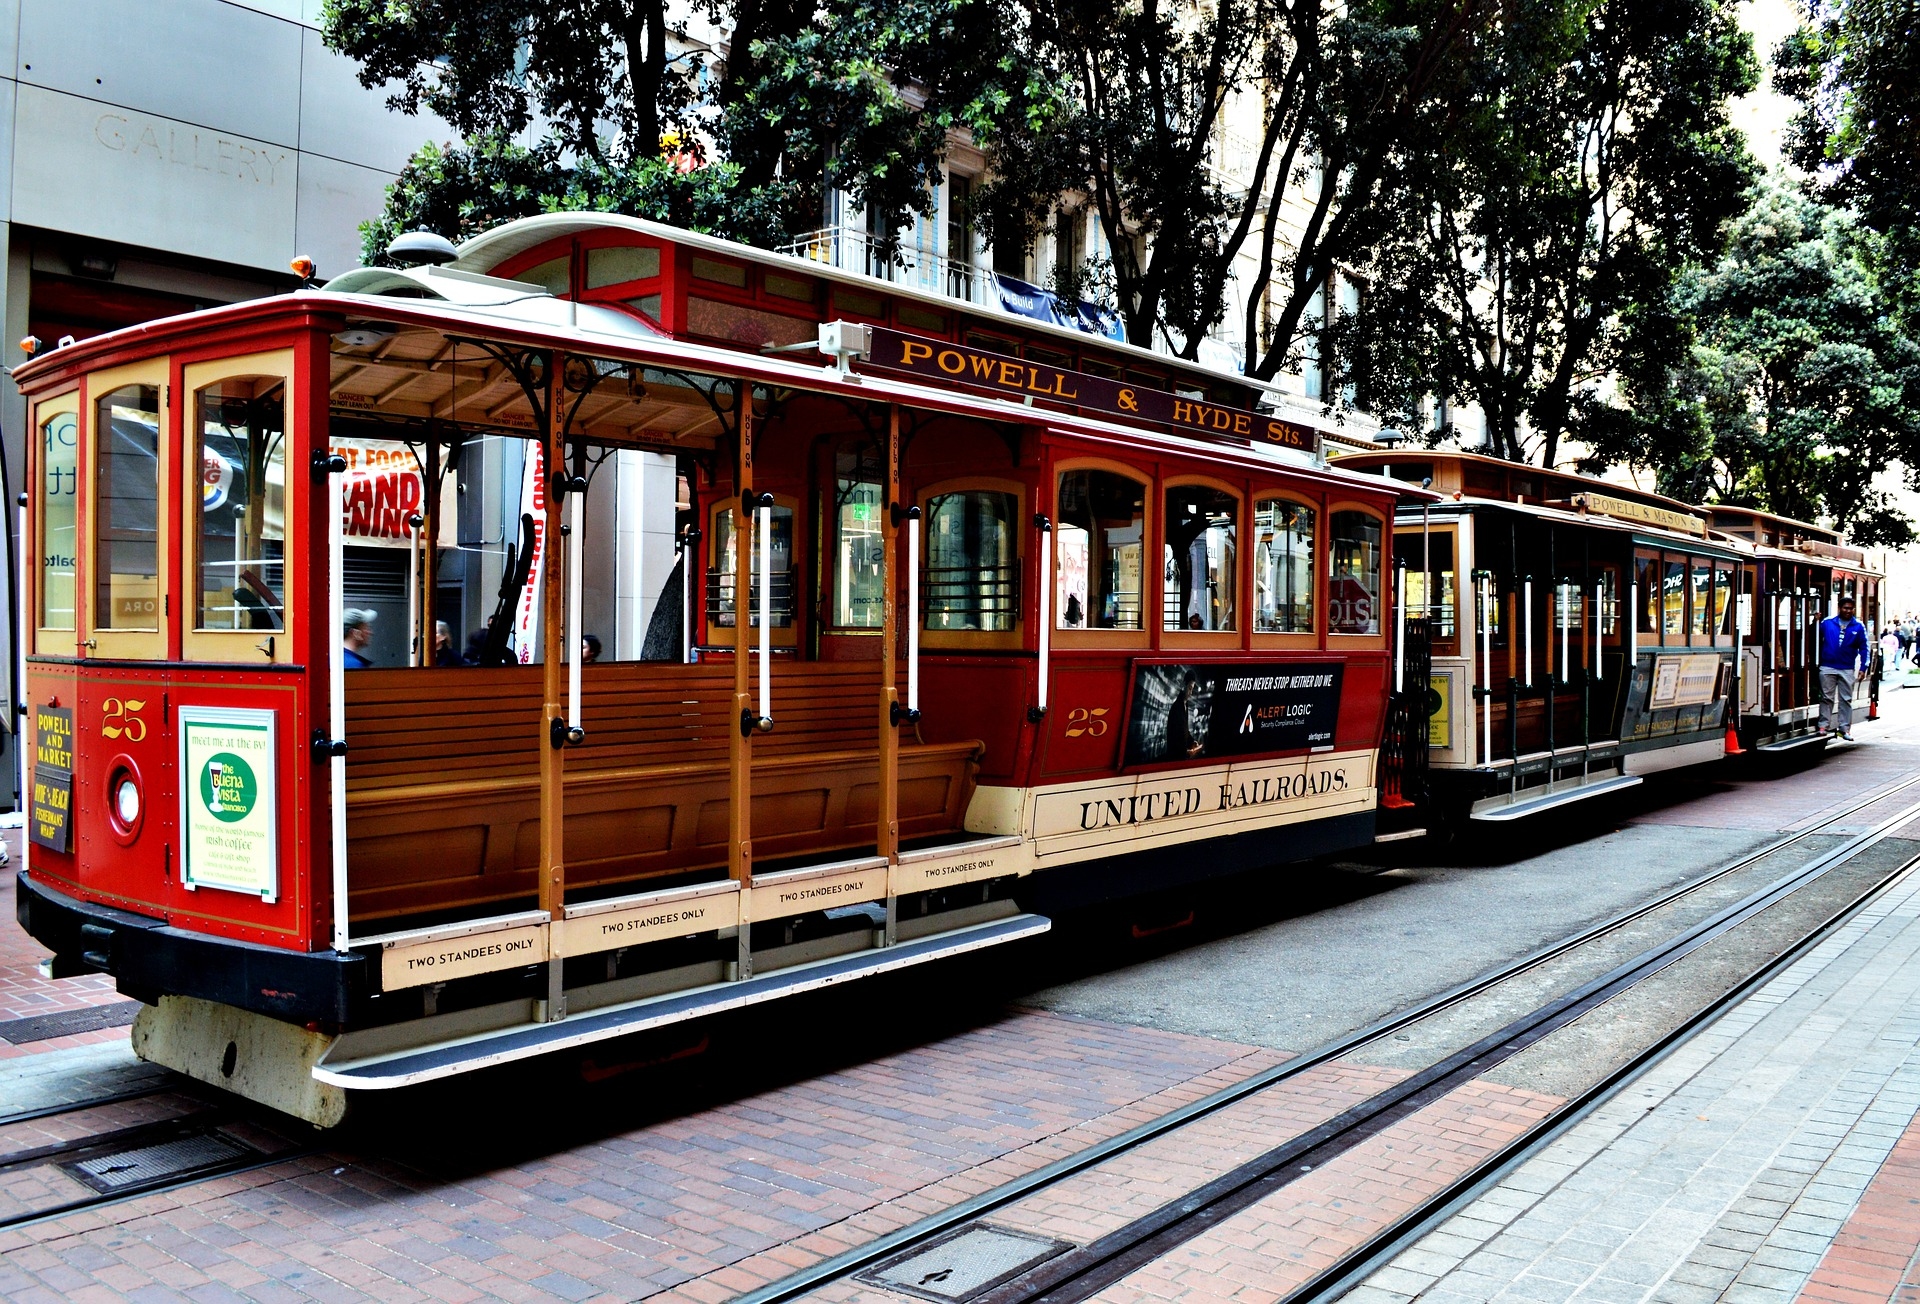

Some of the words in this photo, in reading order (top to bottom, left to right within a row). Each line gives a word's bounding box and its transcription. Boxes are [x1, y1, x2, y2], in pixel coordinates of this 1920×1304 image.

[95, 114, 285, 185] GALLERY
[1011, 293, 1034, 310] Build
[338, 393, 365, 402] DANGER
[900, 340, 1077, 399] POWELL
[1117, 388, 1139, 412] &
[1173, 401, 1251, 435] HYDE
[1267, 422, 1303, 446] Sts.
[502, 412, 525, 421] DANGER
[556, 431, 562, 449] ON
[329, 447, 359, 470] AT
[745, 453, 751, 468] ON
[893, 469, 898, 485] ON
[1592, 497, 1639, 518] POWELL
[1643, 511, 1650, 519] &
[1653, 510, 1687, 527] MASON
[1225, 677, 1253, 692] THREATS
[1253, 676, 1273, 690] NEVER
[1290, 675, 1314, 689] NEITHER
[1314, 674, 1323, 687] DO
[102, 697, 147, 742] 25
[1064, 707, 1110, 738] 25
[1256, 706, 1286, 719] ALERT
[38, 713, 71, 735] POWELL
[1260, 721, 1275, 729] Security
[1275, 719, 1294, 728] Compliance
[46, 735, 63, 749] AND
[1308, 732, 1331, 741] alertlogic.com
[38, 746, 71, 769] MARKET
[35, 783, 46, 804] HYDE
[52, 789, 68, 810] BEACH
[35, 807, 63, 827] FISHERMANS
[1080, 787, 1201, 830] UNITED
[40, 824, 56, 839] WHARF
[925, 868, 941, 878] TWO
[942, 862, 977, 875] STANDEES
[978, 859, 995, 868] ONLY
[779, 891, 798, 902] TWO
[800, 885, 842, 899] STANDEES
[844, 881, 864, 892] ONLY
[602, 922, 624, 935] TWO
[627, 913, 679, 931] STANDEES
[681, 908, 706, 920] ONLY
[407, 956, 435, 970] TWO
[439, 944, 502, 965] STANDEES
[505, 938, 534, 952] ONLY
